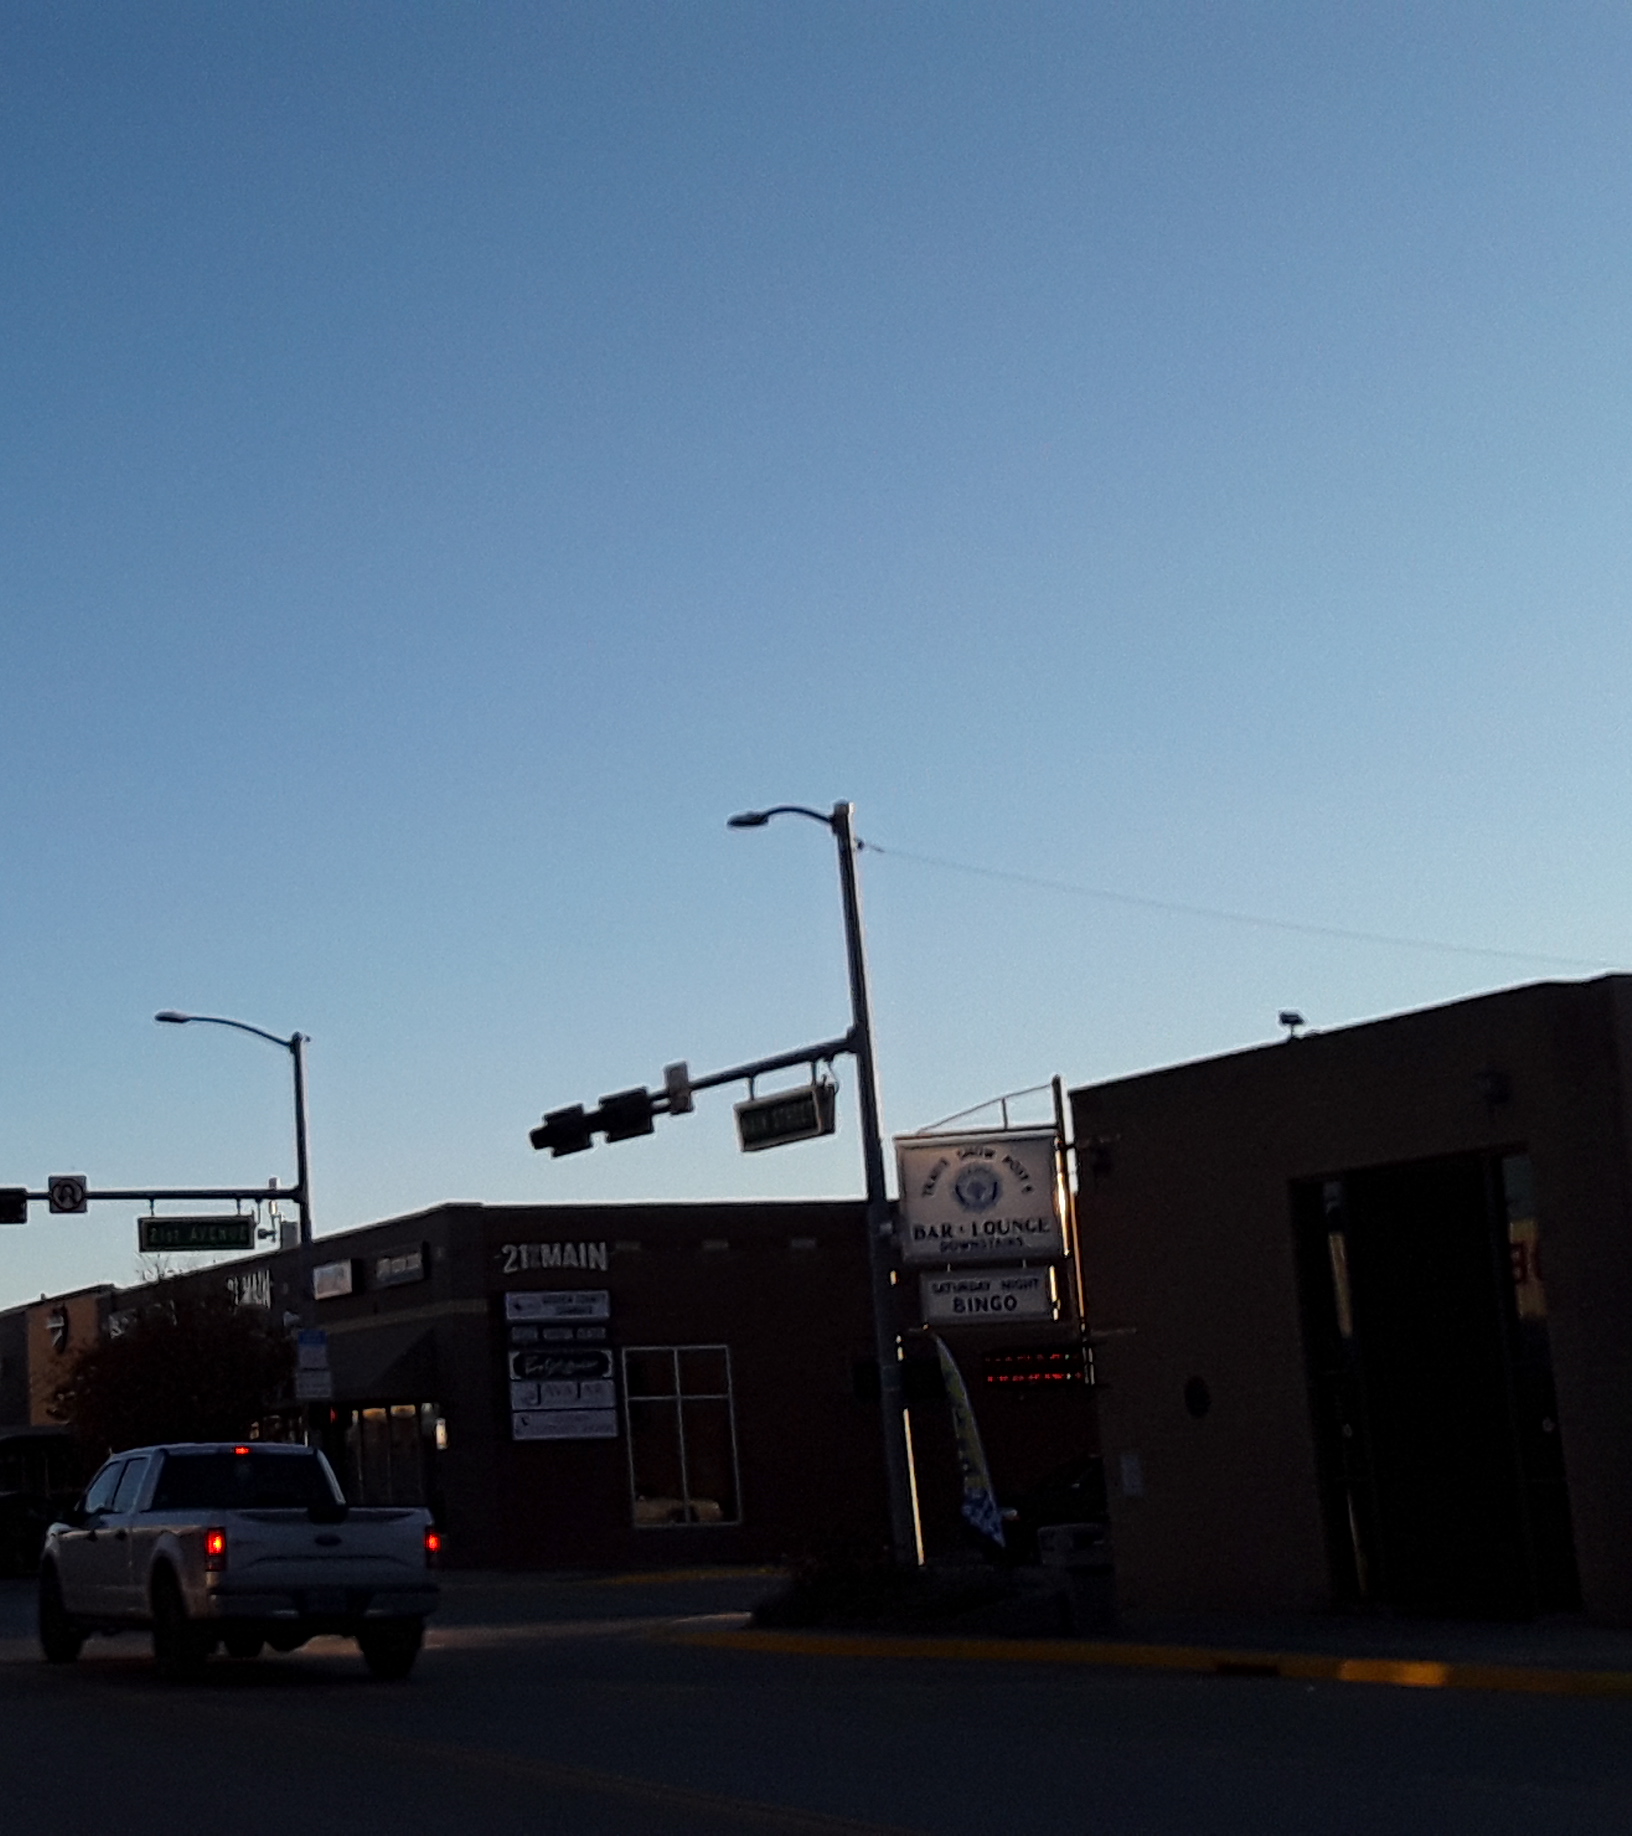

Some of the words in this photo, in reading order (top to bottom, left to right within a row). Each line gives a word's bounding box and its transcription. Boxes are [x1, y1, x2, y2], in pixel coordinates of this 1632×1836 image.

[188, 1225, 246, 1242] AVENUE
[913, 1223, 953, 1241] BAR
[971, 1218, 1051, 1237] LOUNGE
[500, 1243, 528, 1274] 21
[539, 1241, 609, 1273] MAIN
[931, 1281, 991, 1295] SATURDAY
[1001, 1277, 1040, 1291] NIGHT
[952, 1295, 1019, 1314] BINGO
